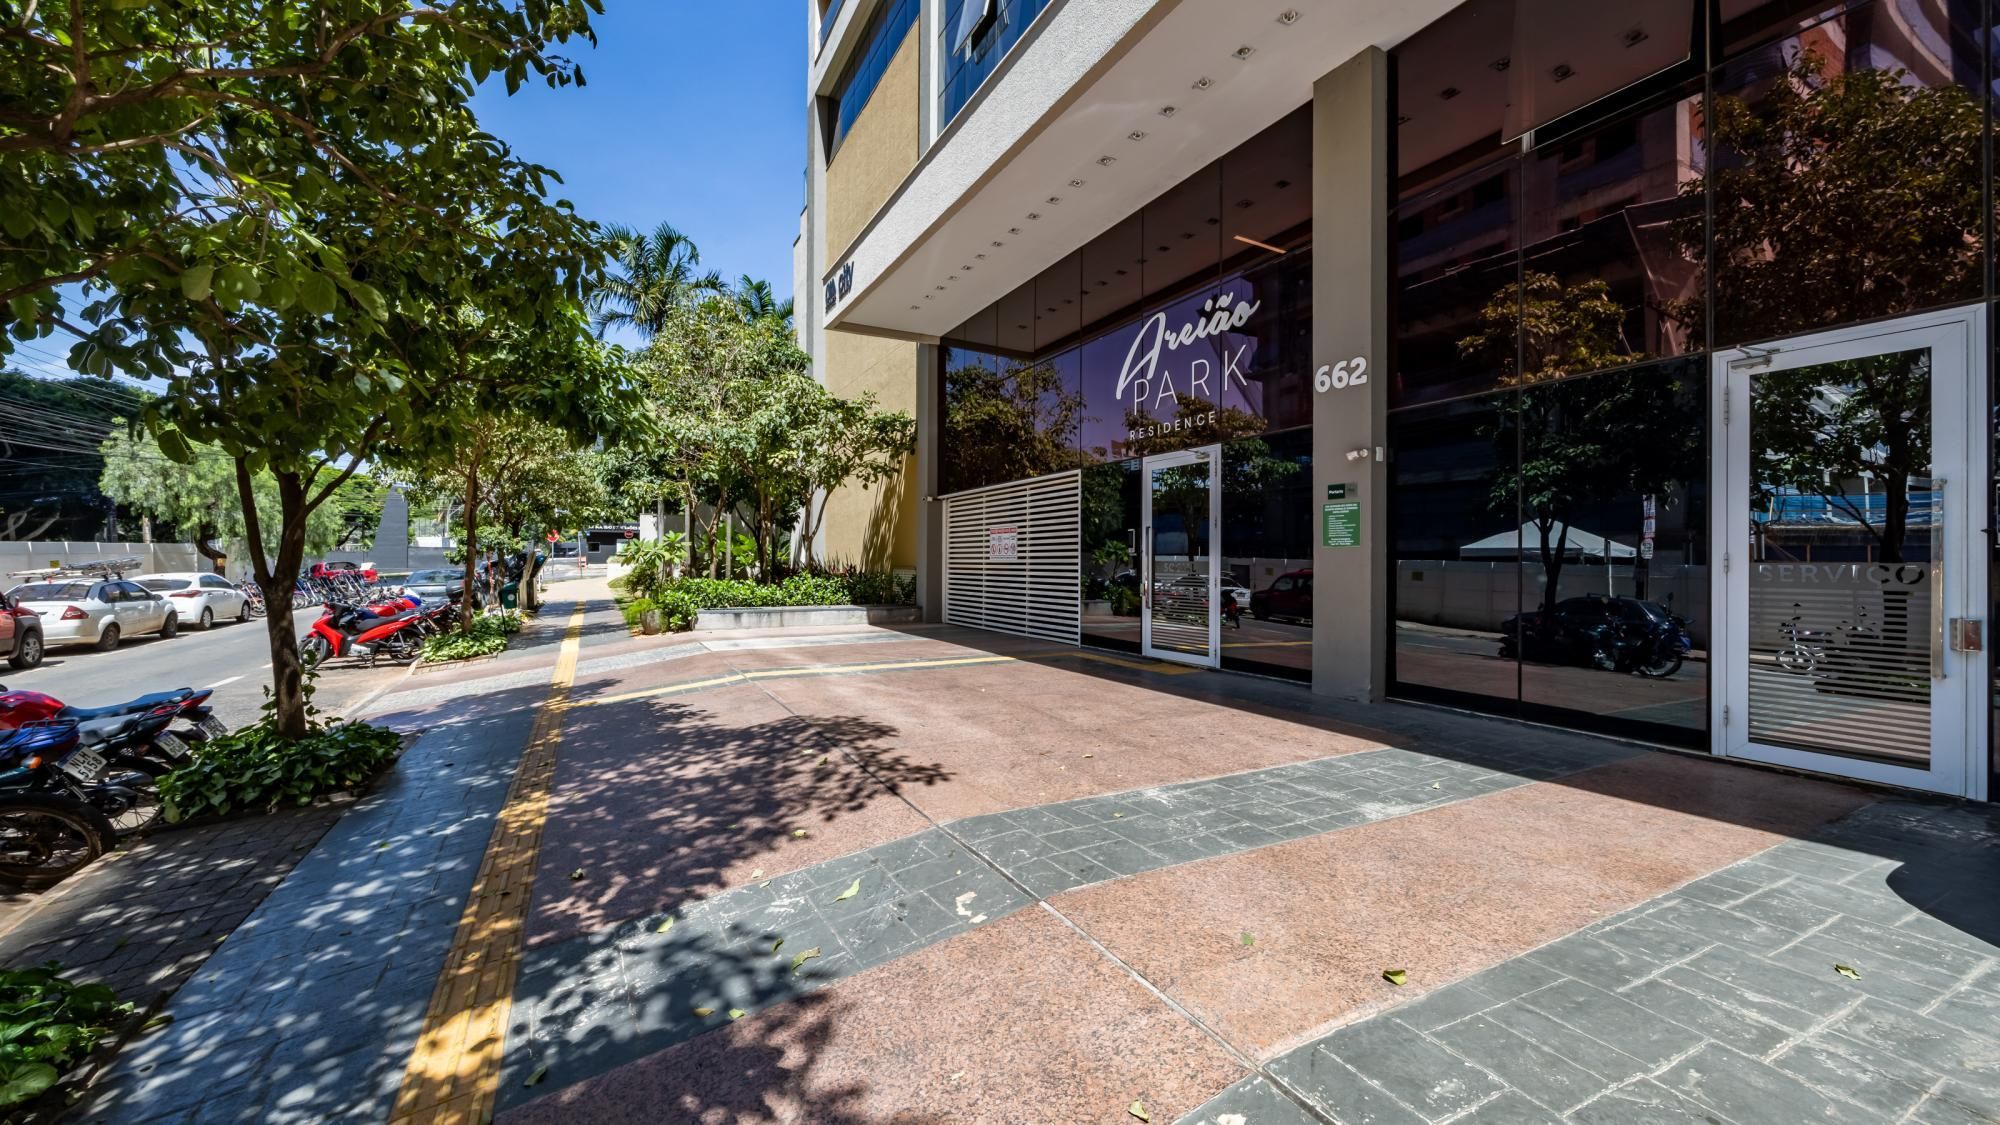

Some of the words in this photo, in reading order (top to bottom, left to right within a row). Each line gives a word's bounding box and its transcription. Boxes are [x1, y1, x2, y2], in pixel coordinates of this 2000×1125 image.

[1116, 292, 1260, 400] Areião
[1134, 344, 1247, 415] PARK
[1314, 356, 1368, 393] 662
[1129, 411, 1216, 441] RESIDENCE
